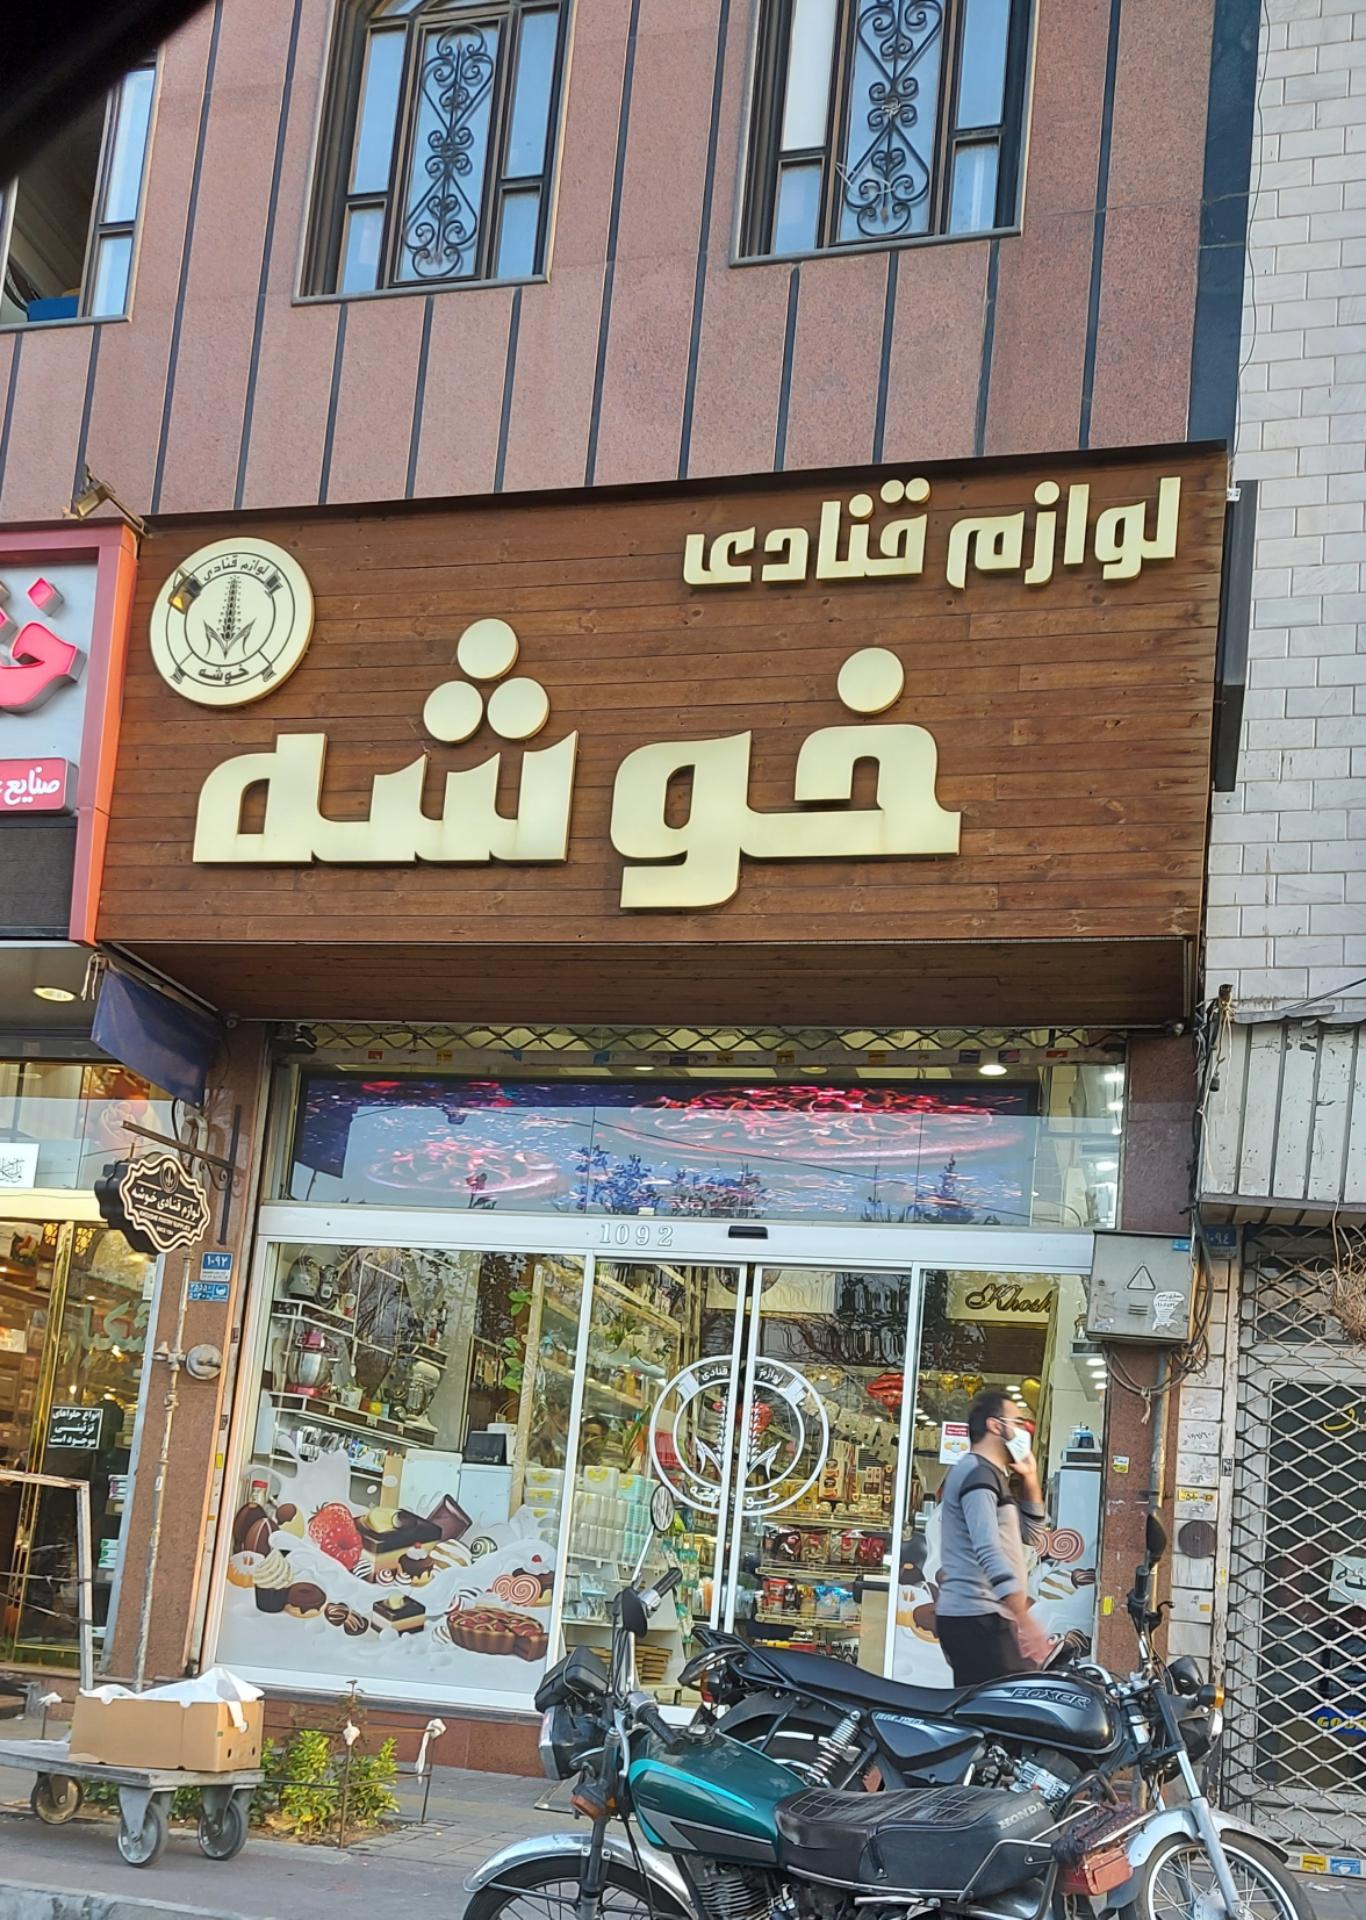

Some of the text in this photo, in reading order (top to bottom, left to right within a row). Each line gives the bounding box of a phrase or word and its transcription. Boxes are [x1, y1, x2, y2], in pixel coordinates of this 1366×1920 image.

[682, 477, 1181, 590] لوازم قنادی
[203, 555, 270, 582] لوازم قنادی
[198, 664, 249, 684] خوشه
[193, 618, 961, 909] خوشه
[4, 766, 60, 805] صنایع
[131, 1187, 158, 1205] خوشه
[157, 1195, 181, 1211] قنادی
[181, 1203, 201, 1221] لوازم
[600, 1223, 673, 1246] 1092
[207, 1255, 228, 1267] ۱۰۹۲
[701, 1366, 784, 1384] لوازم قنادی
[1010, 1688, 1092, 1710] BOXER
[997, 1801, 1045, 1829] HONDA
